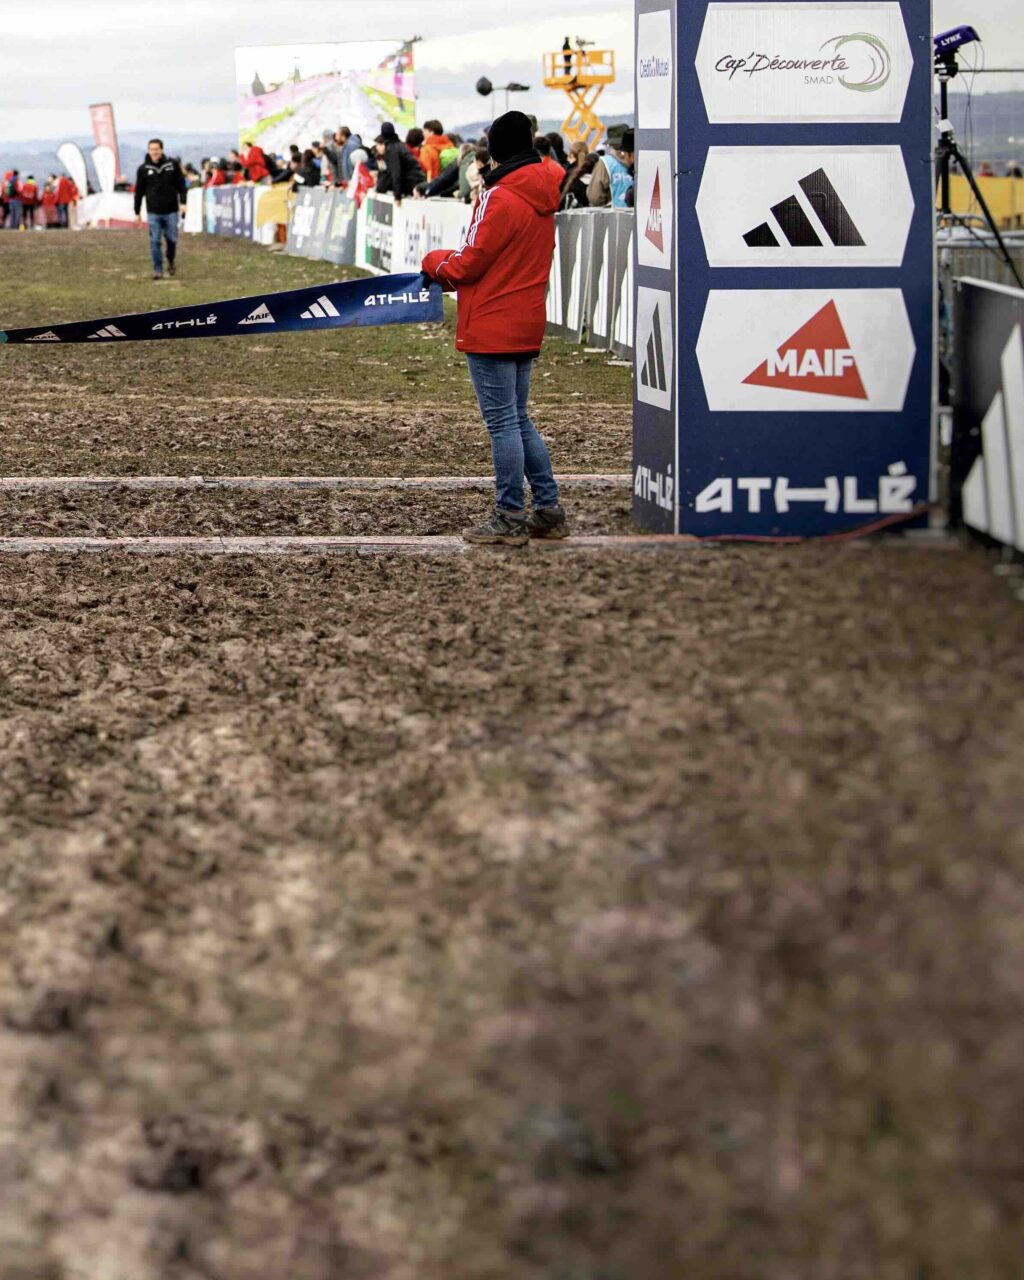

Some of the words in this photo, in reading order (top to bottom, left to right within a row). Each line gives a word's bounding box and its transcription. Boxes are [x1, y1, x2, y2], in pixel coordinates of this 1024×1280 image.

[940, 32, 962, 46] LYNX
[804, 75, 834, 85] SMAD
[364, 287, 430, 306] ATHLÉ
[151, 313, 218, 331] ATHLÉ
[244, 312, 271, 322] MAIF
[767, 349, 856, 377] MAIF
[635, 463, 674, 511] ATHLÉ
[695, 461, 917, 513] ATHLÉ
